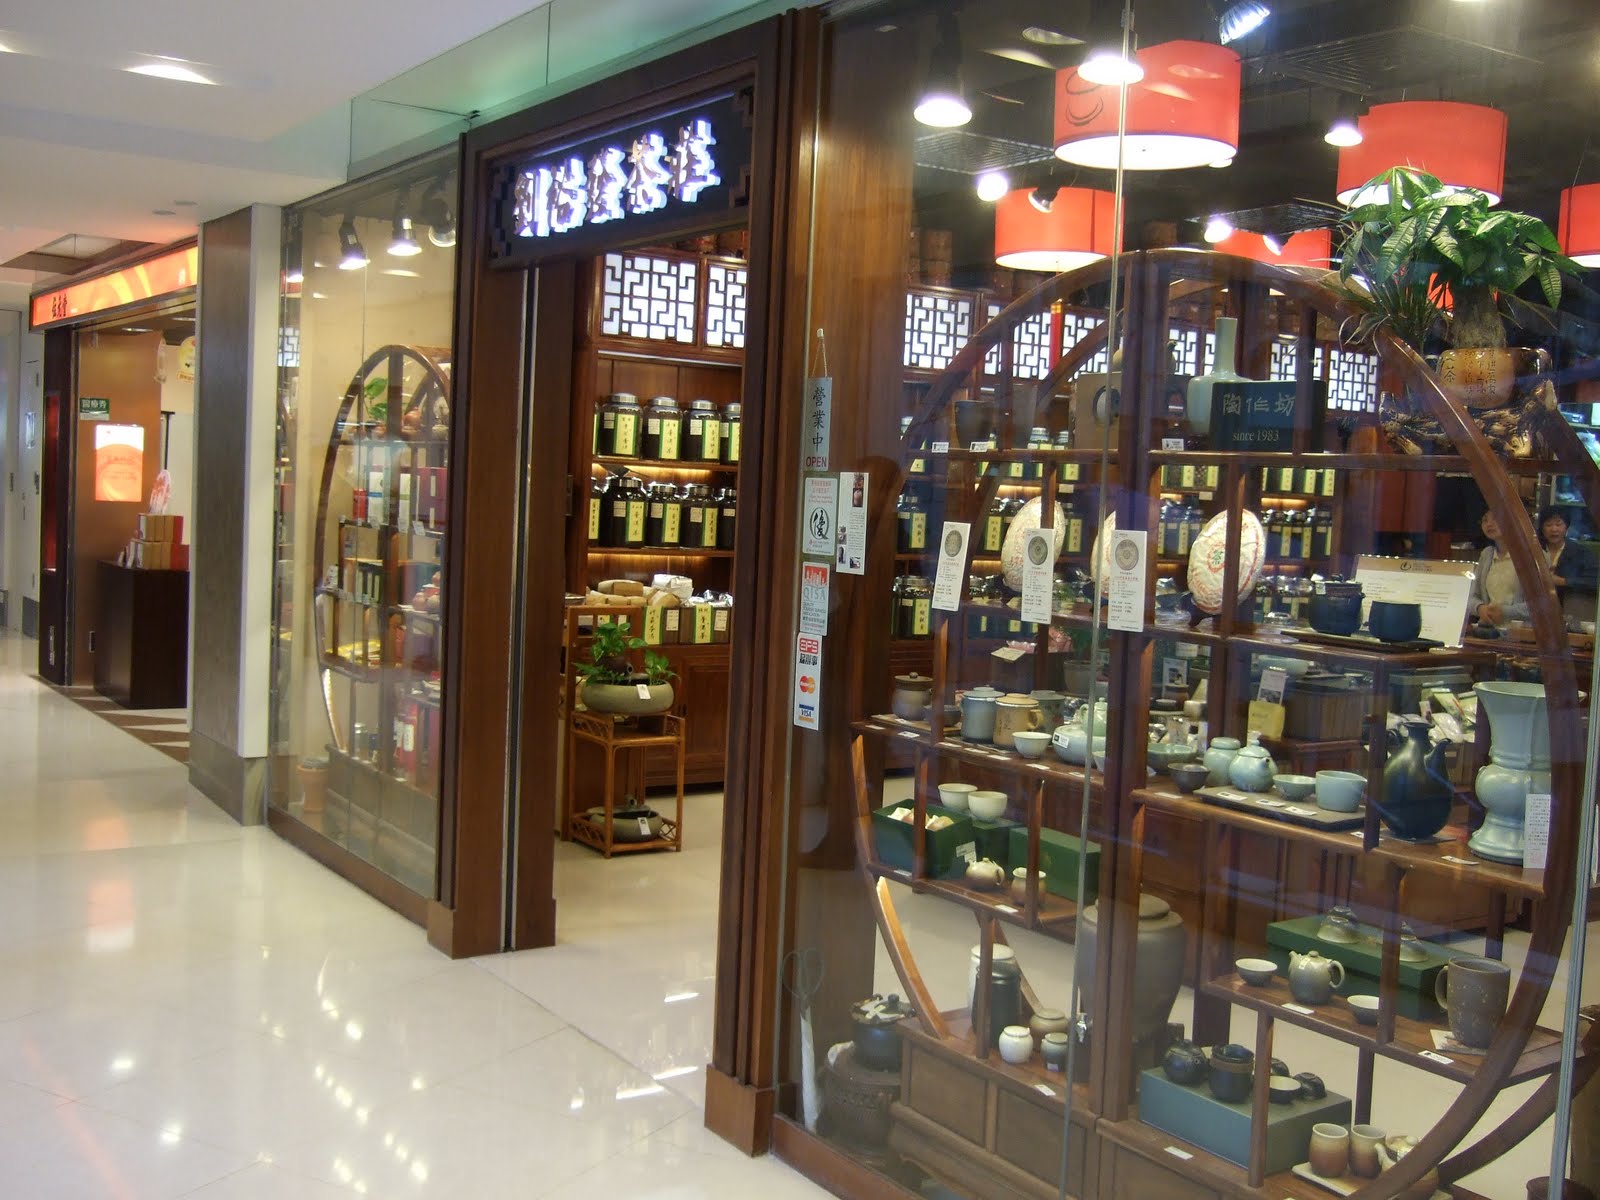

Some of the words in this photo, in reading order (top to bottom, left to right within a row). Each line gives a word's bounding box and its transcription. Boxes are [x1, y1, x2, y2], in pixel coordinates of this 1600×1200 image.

[812, 386, 826, 452] 營業中
[1232, 430, 1254, 442] since
[1256, 429, 1280, 442] 1983
[805, 456, 827, 468] OPEN
[800, 639, 818, 653] EPS
[801, 708, 812, 718] VISA
